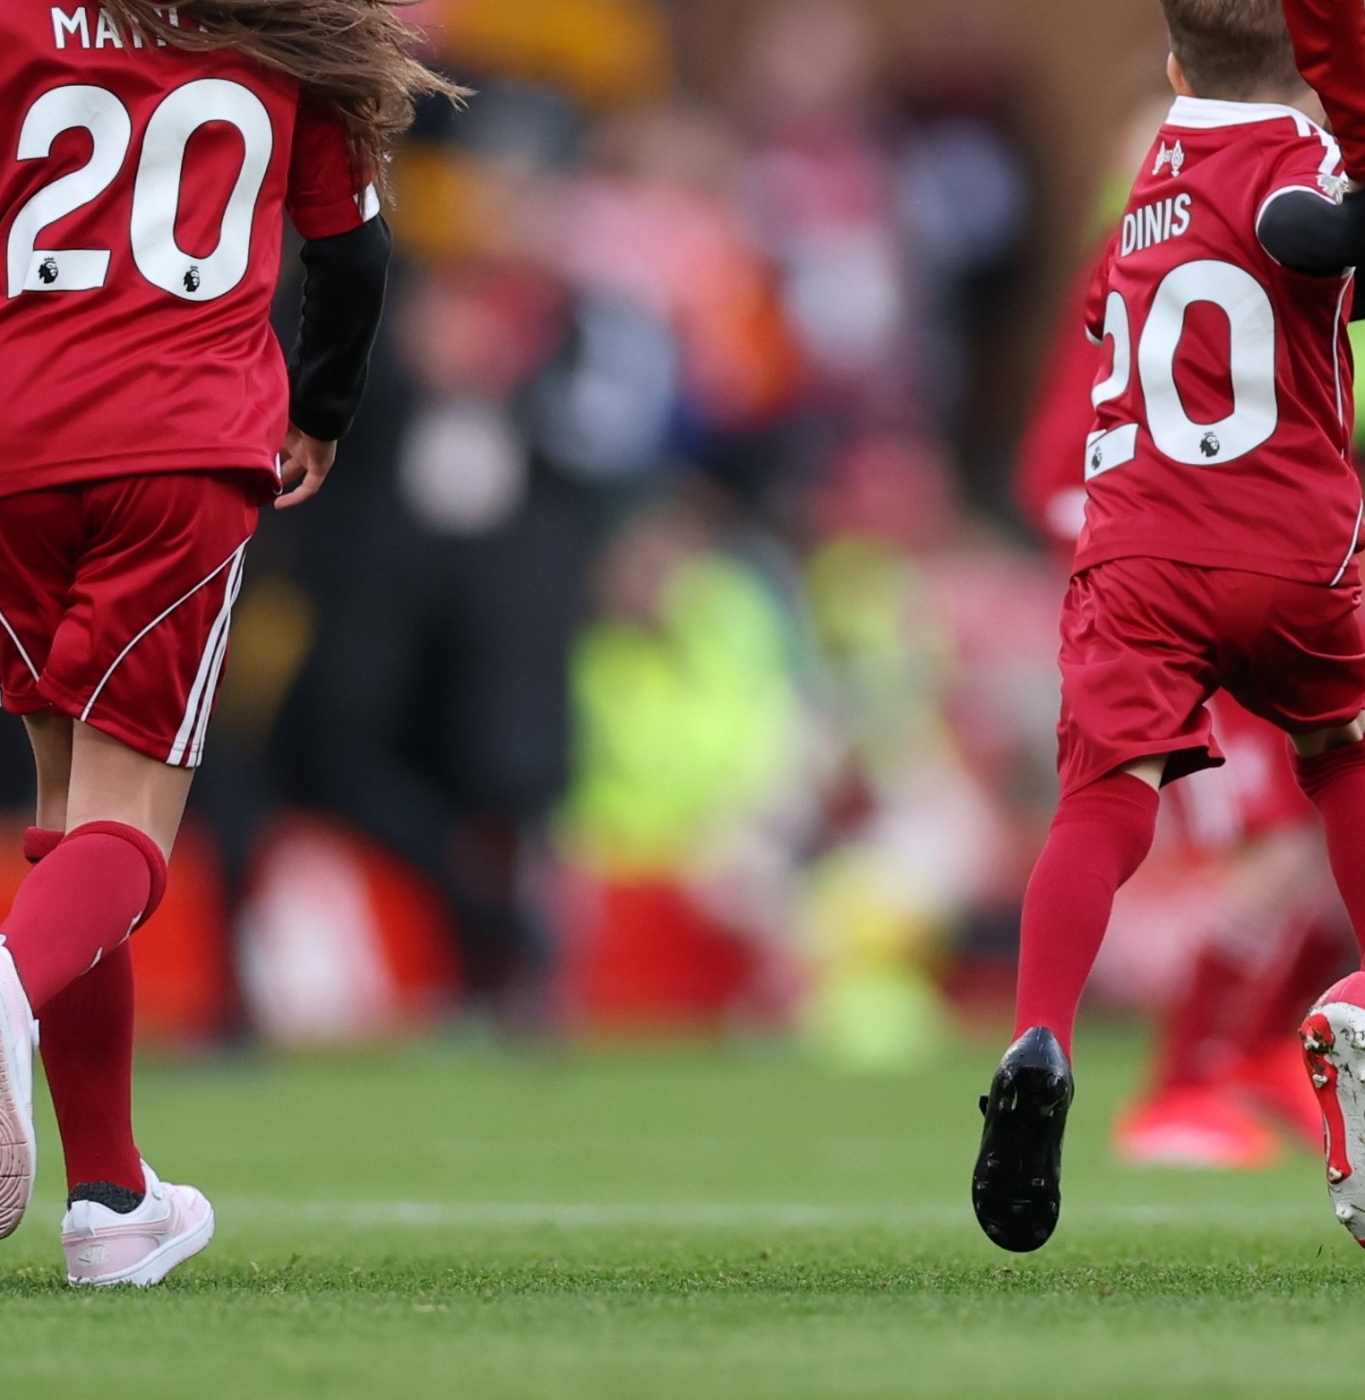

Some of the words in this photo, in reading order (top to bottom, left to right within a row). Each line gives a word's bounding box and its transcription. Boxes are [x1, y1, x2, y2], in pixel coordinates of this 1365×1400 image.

[7, 78, 273, 301] 20
[1120, 192, 1192, 258] DINIS
[1084, 259, 1278, 482] 20
